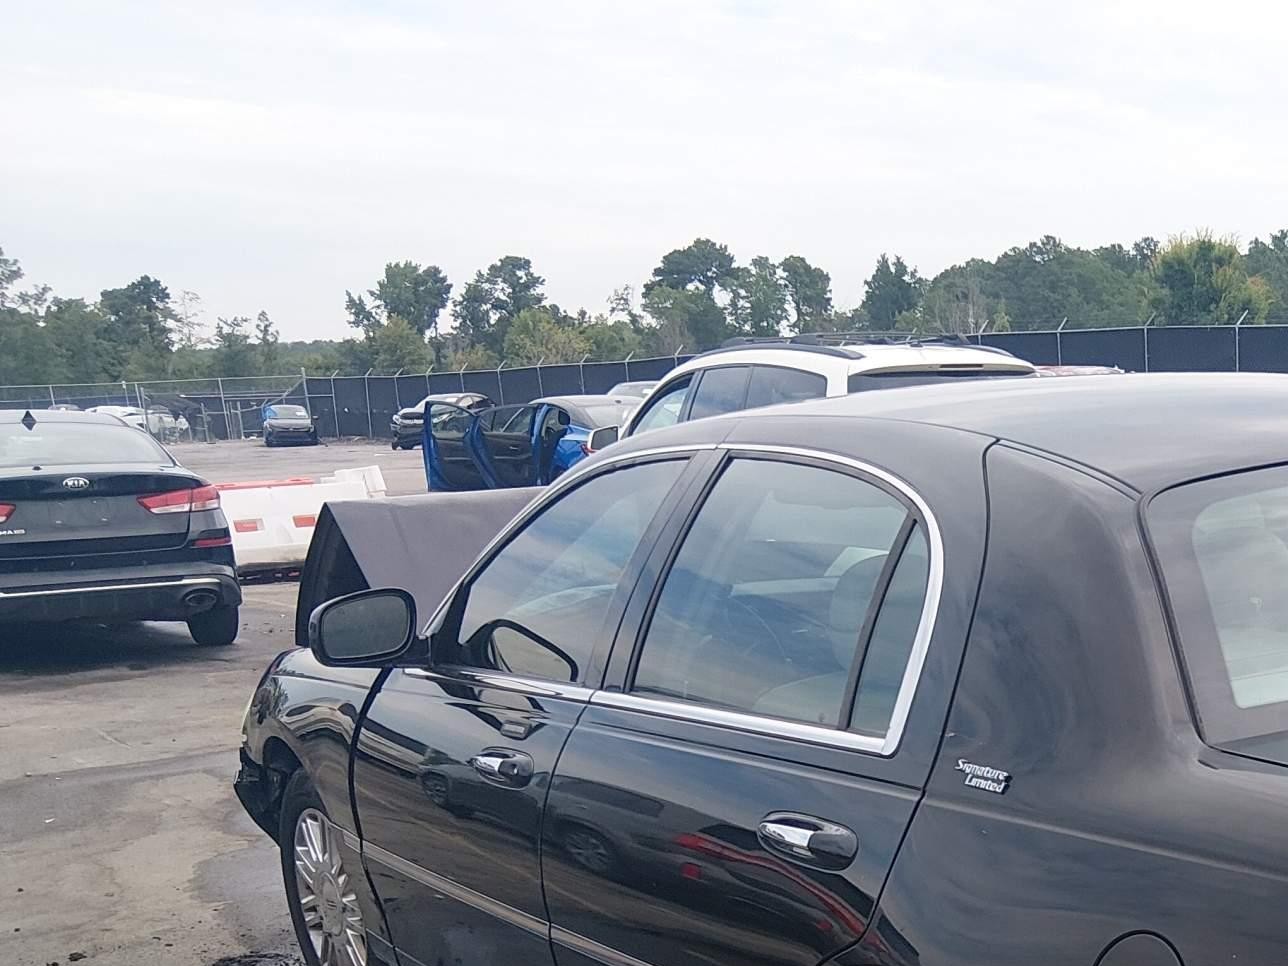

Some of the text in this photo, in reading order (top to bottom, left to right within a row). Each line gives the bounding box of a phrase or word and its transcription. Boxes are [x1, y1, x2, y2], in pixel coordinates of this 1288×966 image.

[64, 478, 89, 490] KIA
[955, 759, 1008, 780] Signature
[965, 774, 1006, 793] Limited
